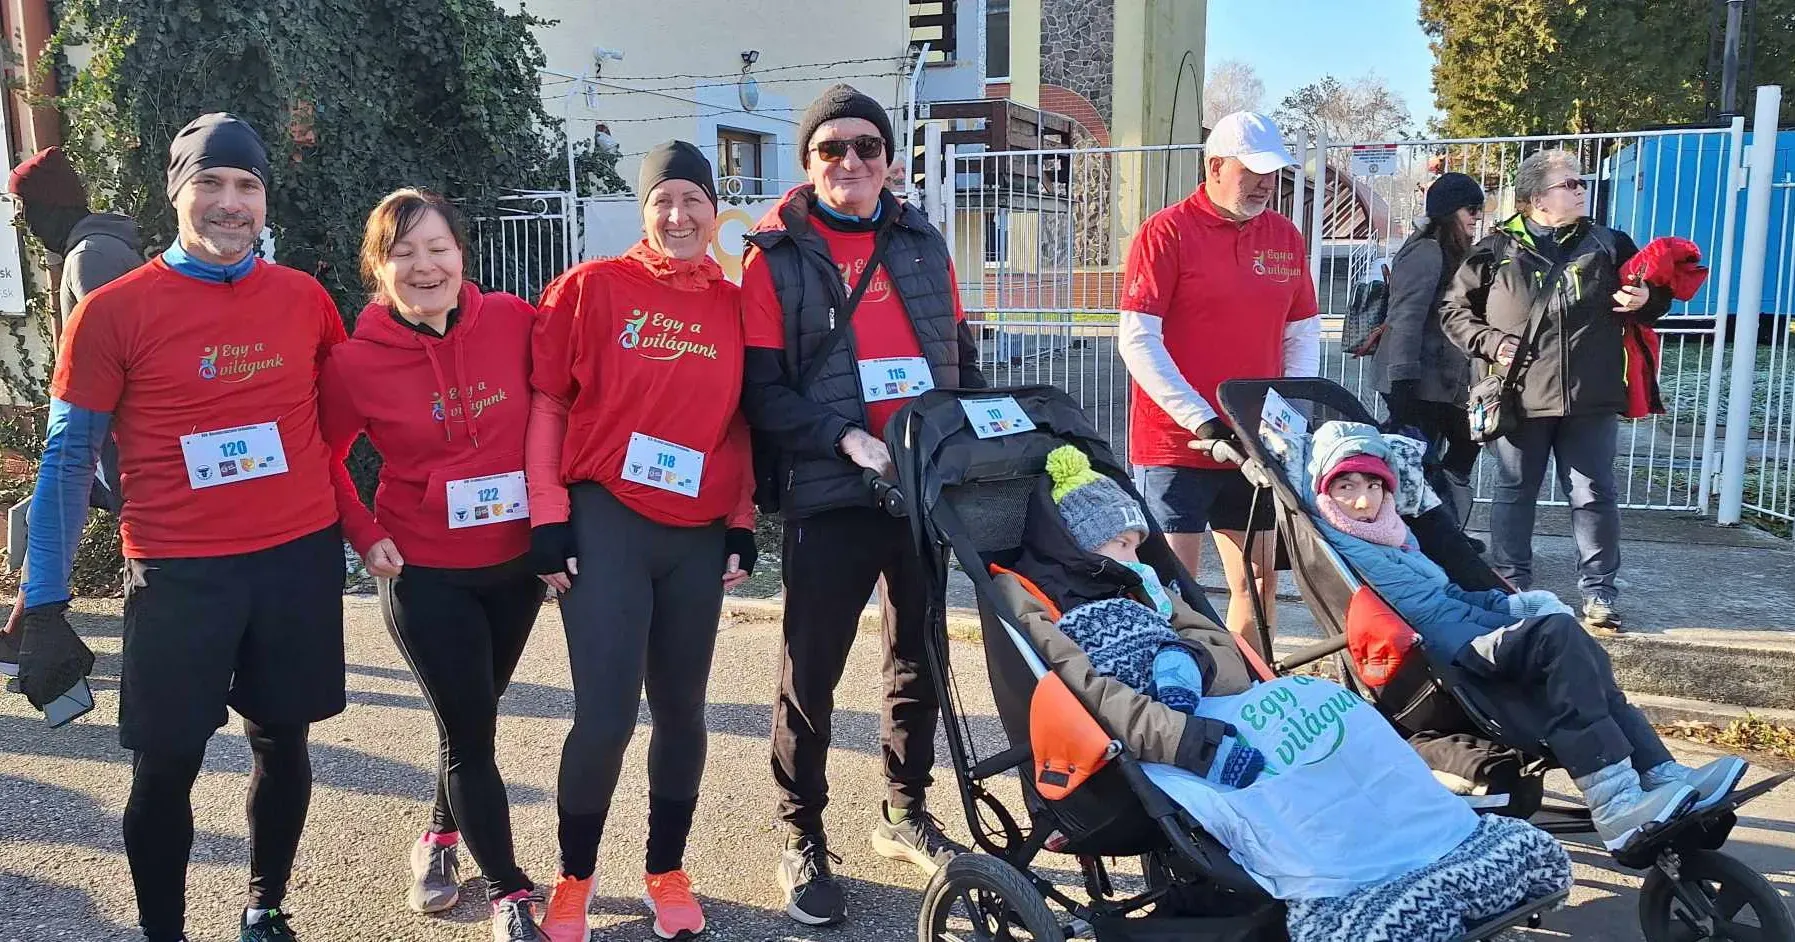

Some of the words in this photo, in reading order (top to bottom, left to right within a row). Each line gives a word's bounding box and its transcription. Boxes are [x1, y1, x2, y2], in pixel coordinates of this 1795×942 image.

[650, 312, 685, 340] Egy
[690, 323, 702, 334] a
[221, 343, 252, 364] Egy
[254, 341, 265, 353] a
[641, 329, 719, 362] világunk
[218, 353, 285, 381] világunk
[887, 368, 907, 380] 115
[448, 386, 474, 402] Ey
[478, 381, 488, 391] a
[986, 408, 1003, 420] 117
[1280, 409, 1291, 424] 121
[219, 440, 248, 458] 120
[656, 452, 676, 469] 118
[477, 487, 500, 503] 122
[1240, 686, 1298, 731] Egy
[1274, 689, 1359, 766] világun
